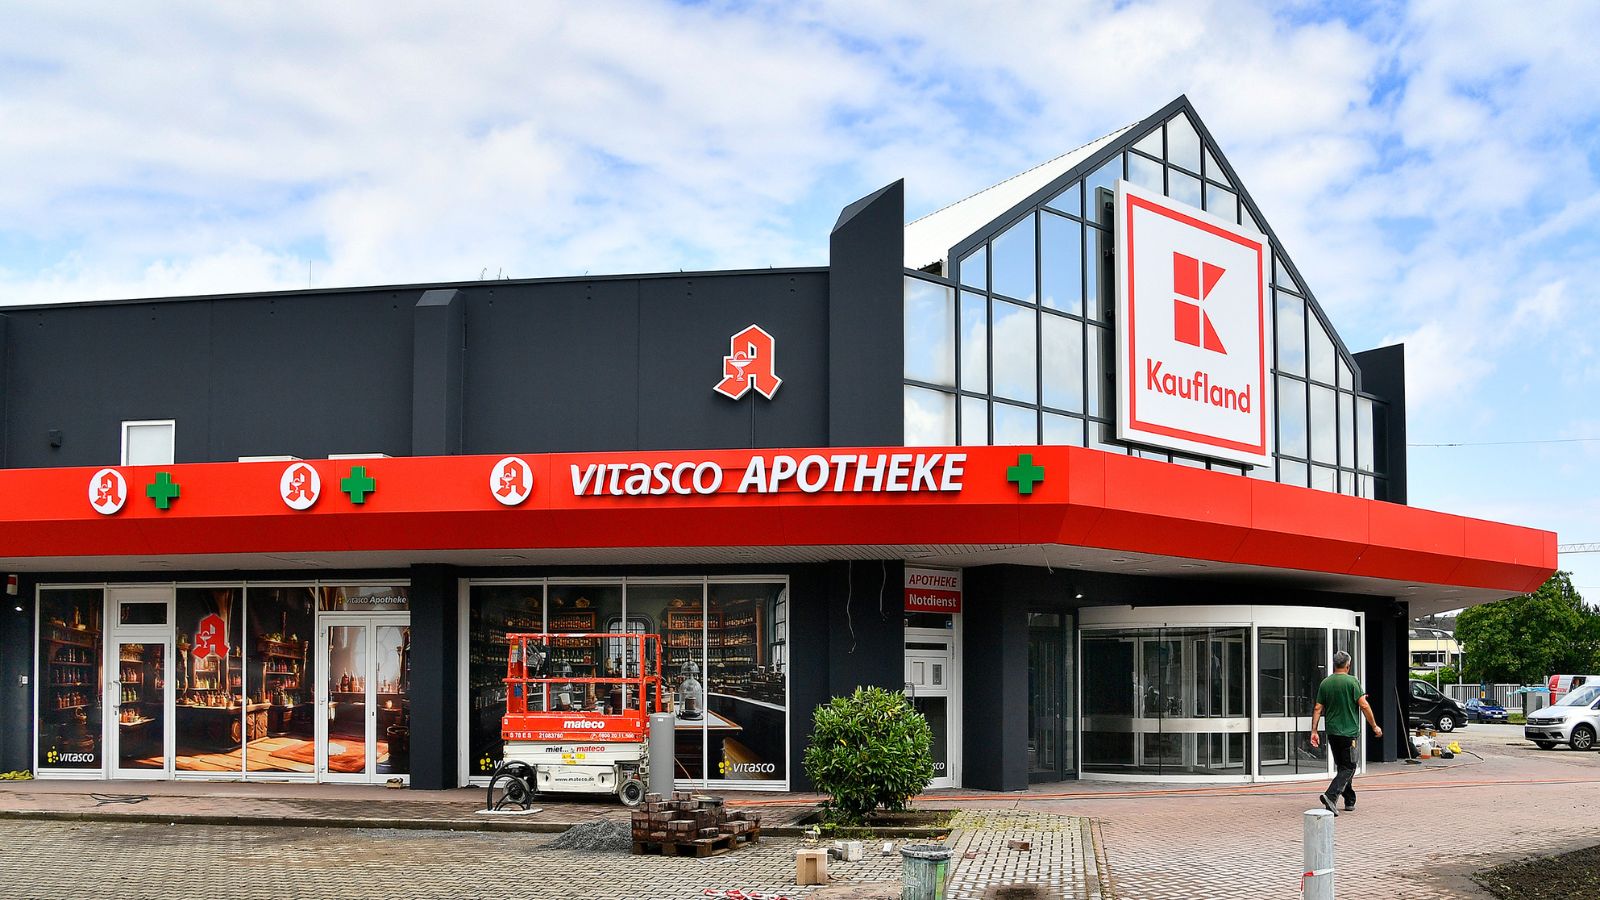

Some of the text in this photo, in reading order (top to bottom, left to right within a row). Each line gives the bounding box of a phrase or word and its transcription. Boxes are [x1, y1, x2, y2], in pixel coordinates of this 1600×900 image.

[1147, 358, 1251, 414] Kaufland
[737, 453, 968, 494] APOTHEKE
[908, 573, 958, 588] APOTHEKE
[369, 595, 407, 605] Apotheke
[909, 593, 957, 608] Notdienst
[563, 719, 605, 729] mateco
